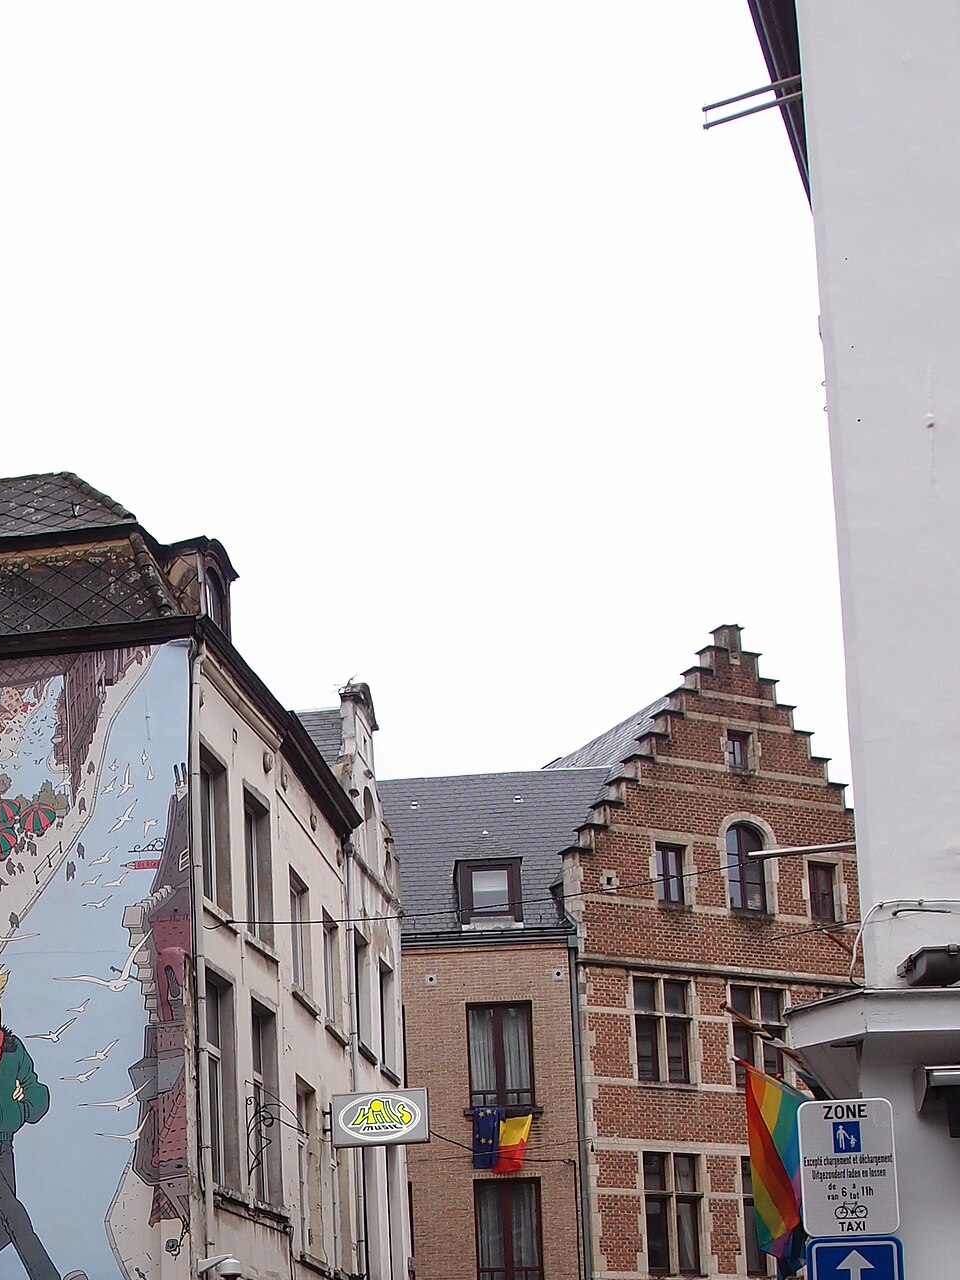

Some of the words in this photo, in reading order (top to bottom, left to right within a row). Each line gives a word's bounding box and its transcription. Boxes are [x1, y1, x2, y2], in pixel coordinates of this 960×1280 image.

[353, 1099, 412, 1125] Hills
[823, 1104, 868, 1119] ZONE
[804, 1156, 823, 1169] Excepté
[823, 1155, 852, 1168] chargement
[852, 1155, 858, 1164] et
[858, 1153, 893, 1166] déchargement
[812, 1169, 846, 1182] Uitgezonderd
[846, 1168, 861, 1178] laden
[869, 1168, 887, 1177] lossen
[841, 1187, 847, 1197] 6
[861, 1186, 874, 1197] 11h
[838, 1221, 866, 1232] TAXI
